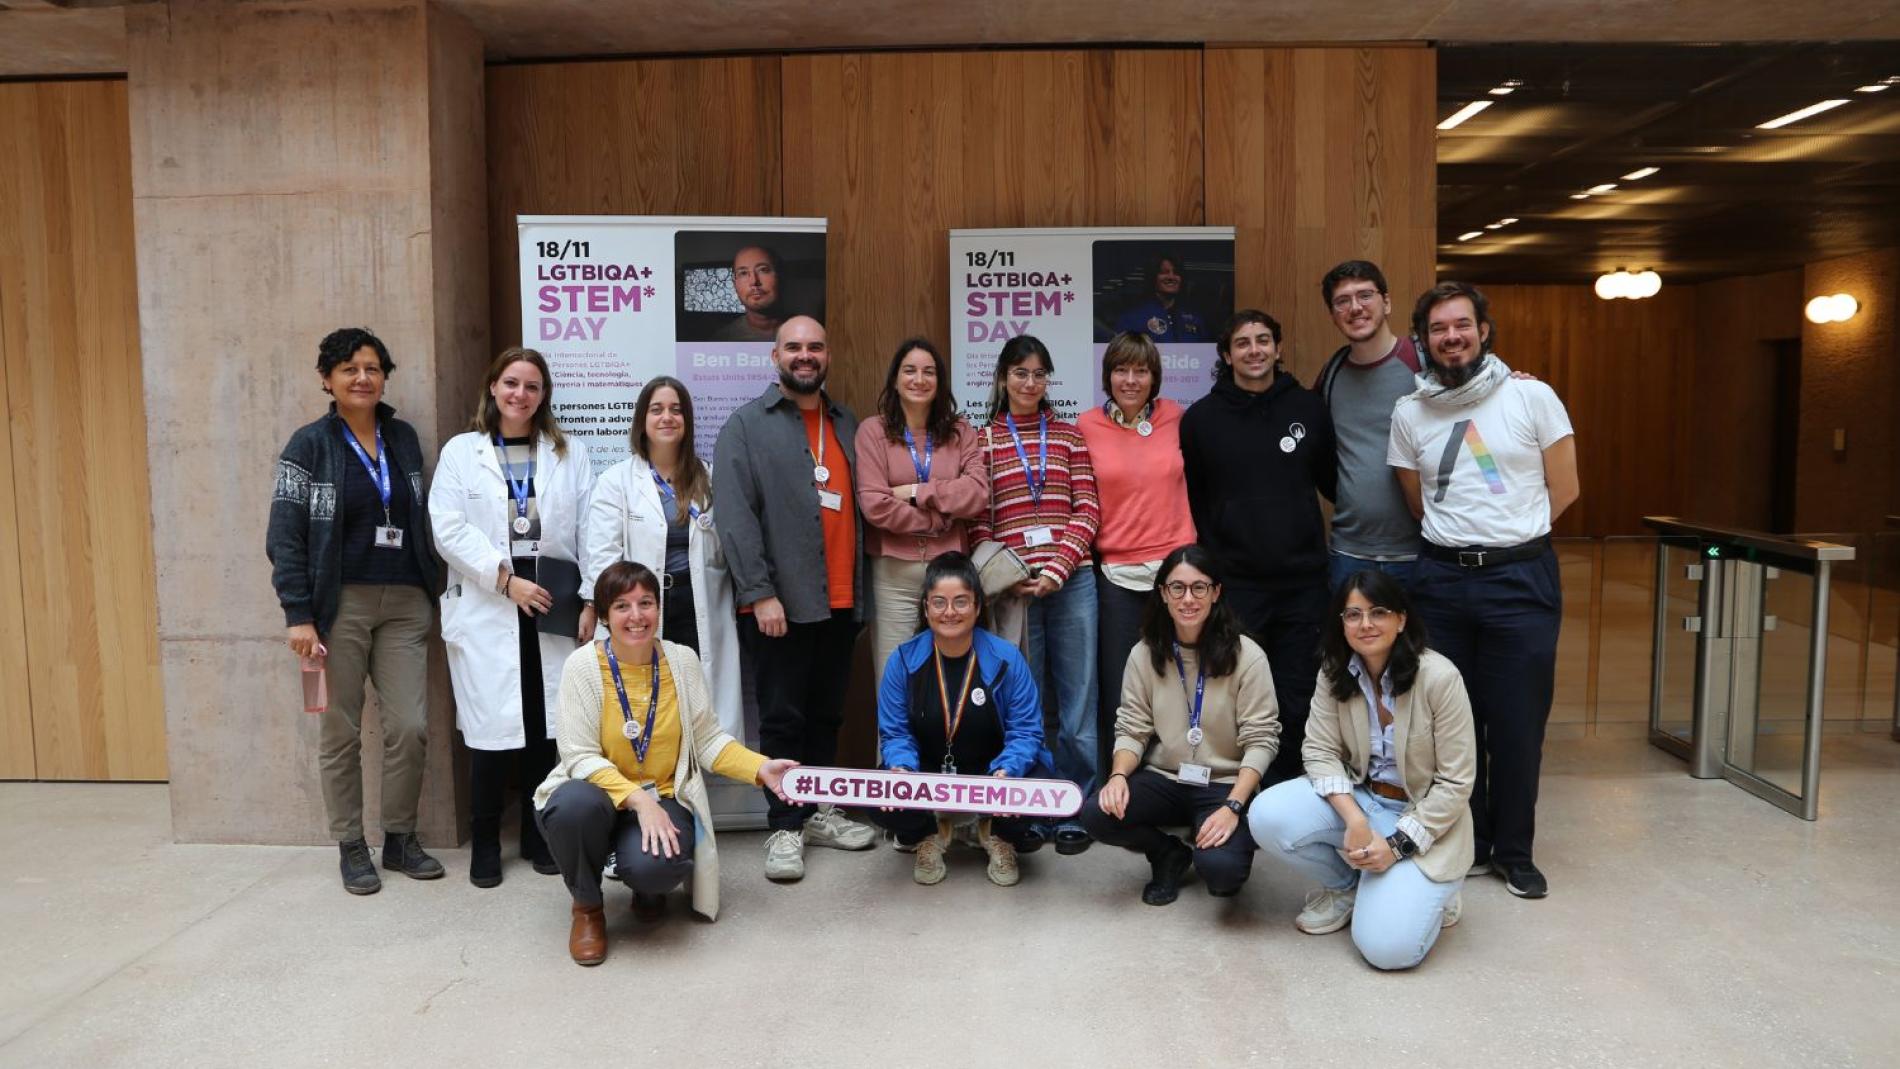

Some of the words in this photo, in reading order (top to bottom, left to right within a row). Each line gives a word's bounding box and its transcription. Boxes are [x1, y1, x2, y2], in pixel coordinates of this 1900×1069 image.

[536, 240, 590, 260] 18/11
[966, 250, 1015, 269] 18/11
[538, 264, 653, 281] LGTBIQA+
[967, 272, 1072, 288] LGTBIQA+
[539, 317, 608, 341] DAY
[967, 321, 1030, 342] DAY
[693, 353, 730, 367] Ben
[736, 353, 774, 367] Bar
[1161, 353, 1200, 369] Ride
[560, 403, 605, 412] persones
[608, 402, 636, 410] LGTB
[555, 415, 597, 424] nfronten
[795, 774, 1068, 809] #LGTBIQASTEMDAY
